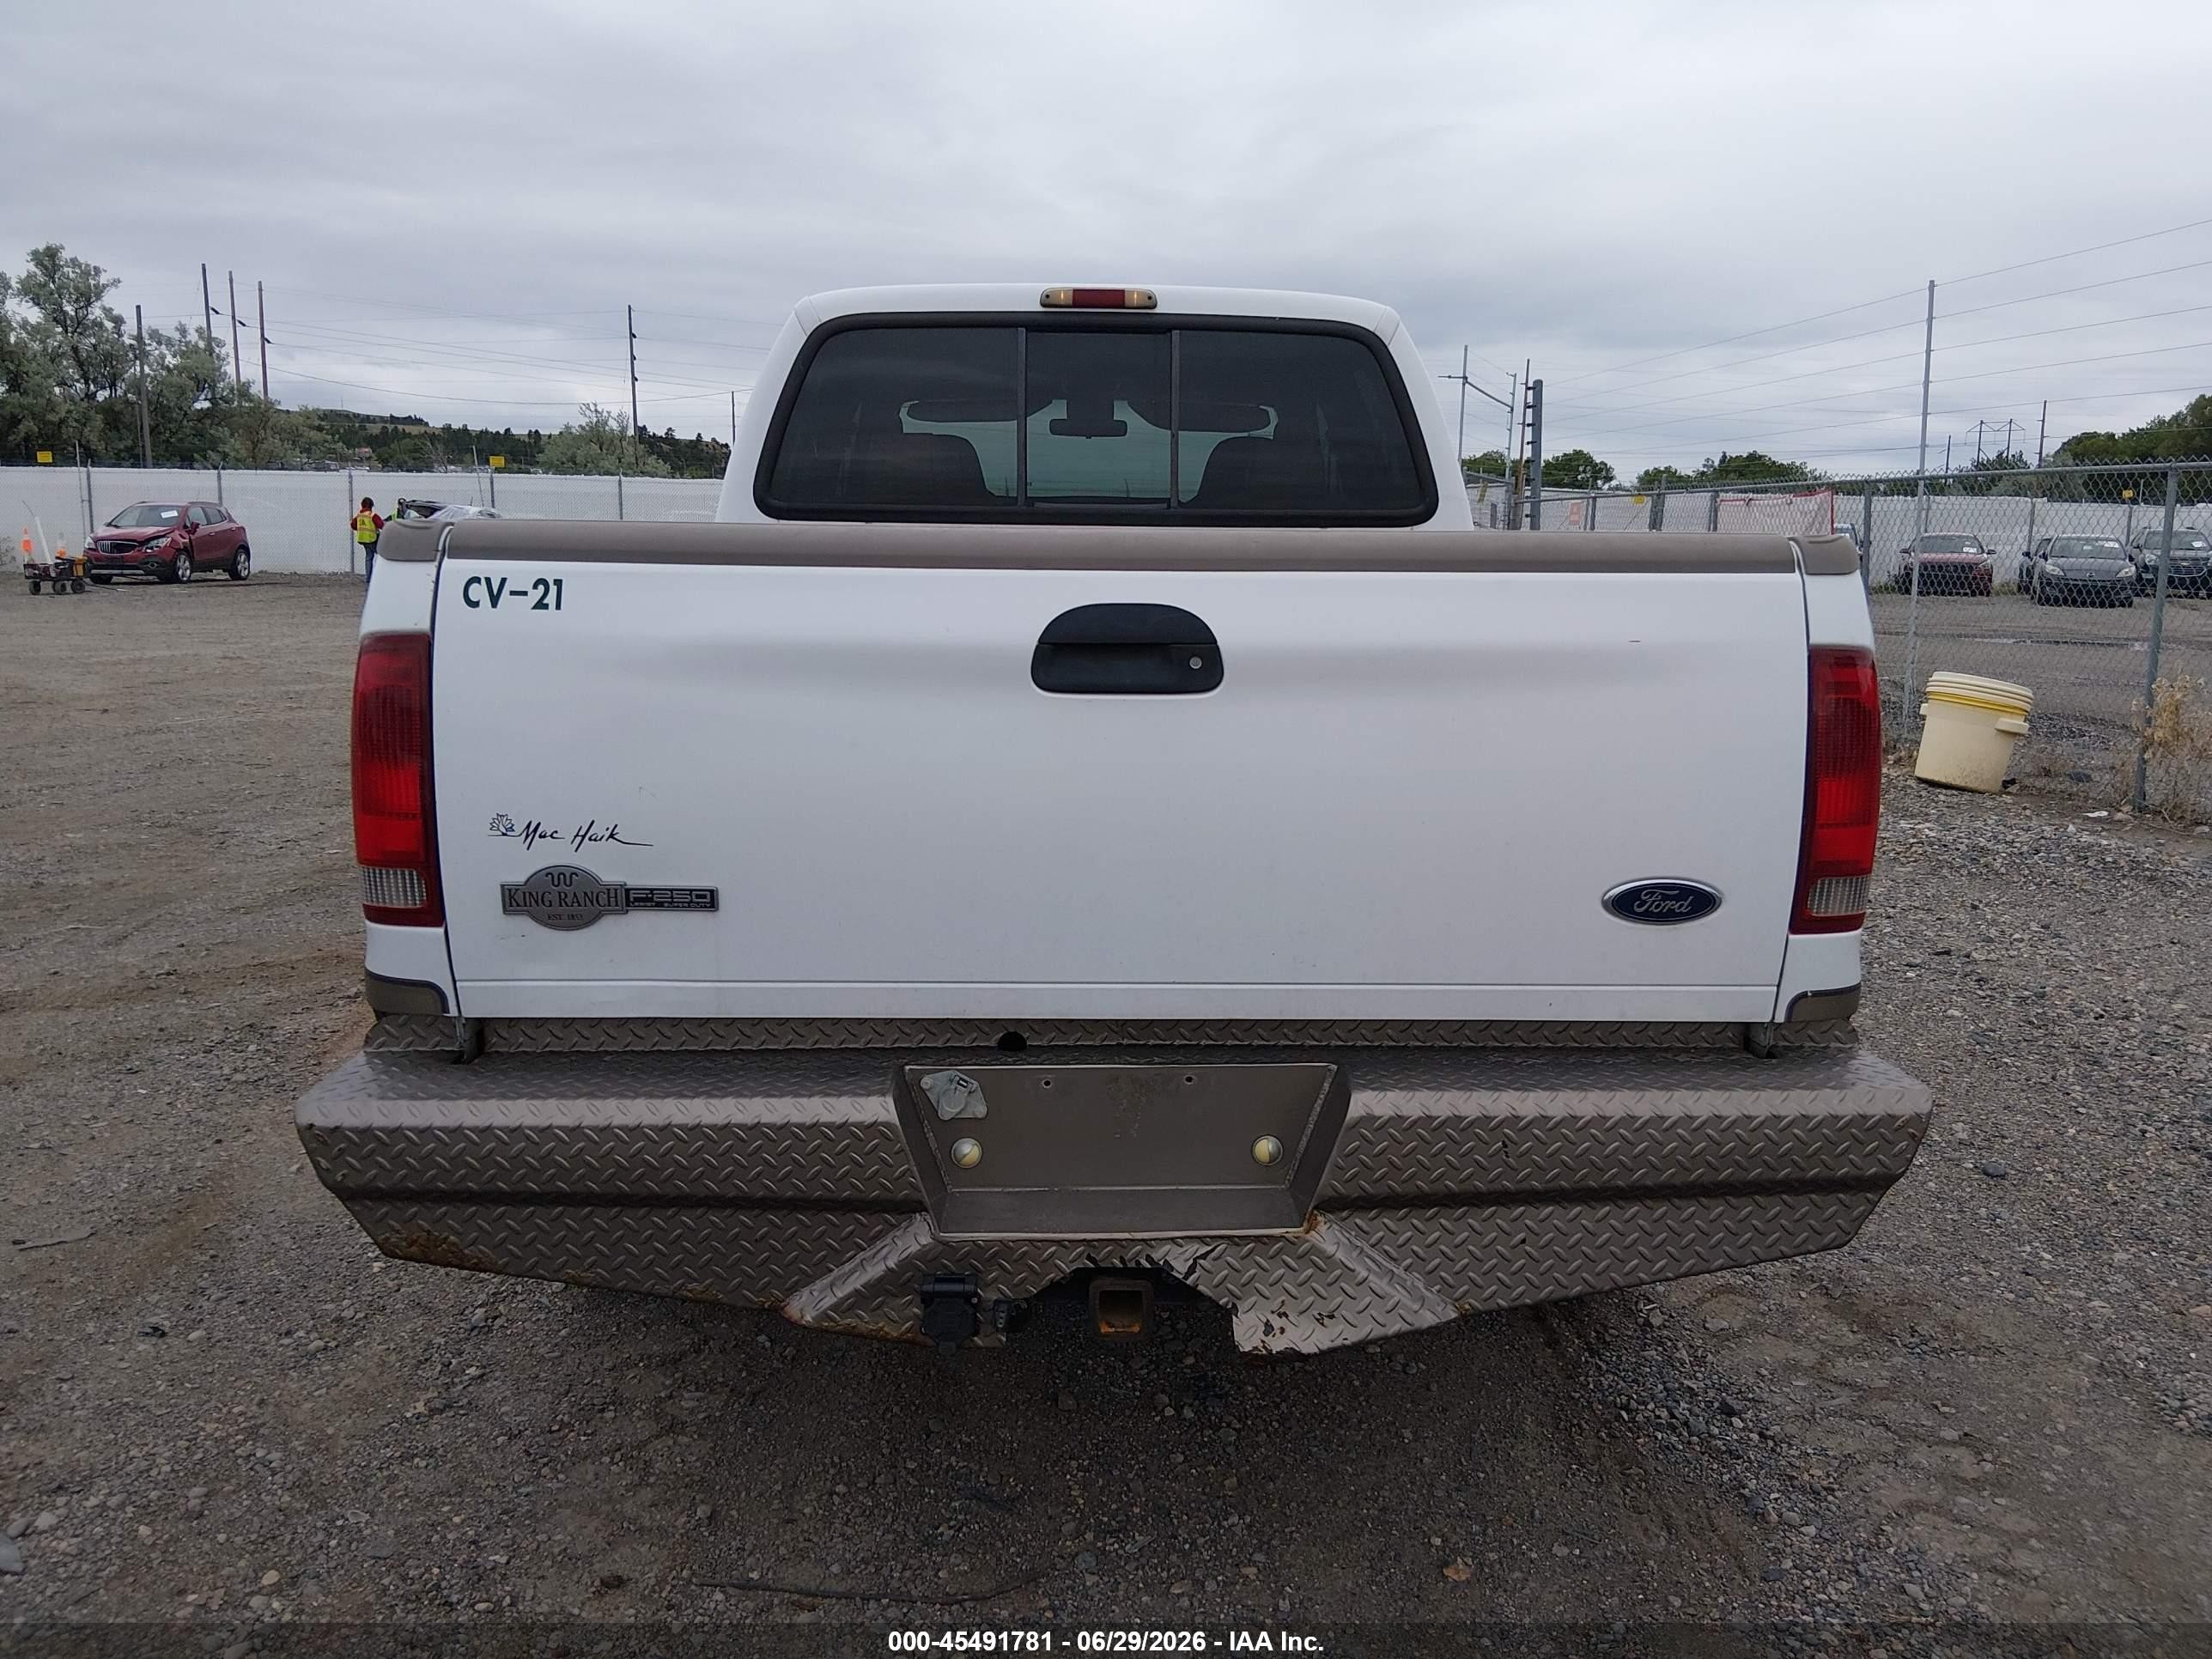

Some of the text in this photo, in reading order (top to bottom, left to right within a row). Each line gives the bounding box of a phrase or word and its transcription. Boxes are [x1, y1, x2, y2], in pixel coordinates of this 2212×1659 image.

[463, 576, 563, 611] CV-21
[520, 819, 653, 853] Mac Haik
[507, 888, 620, 908] KING RANCH
[1633, 889, 1694, 913] Ford
